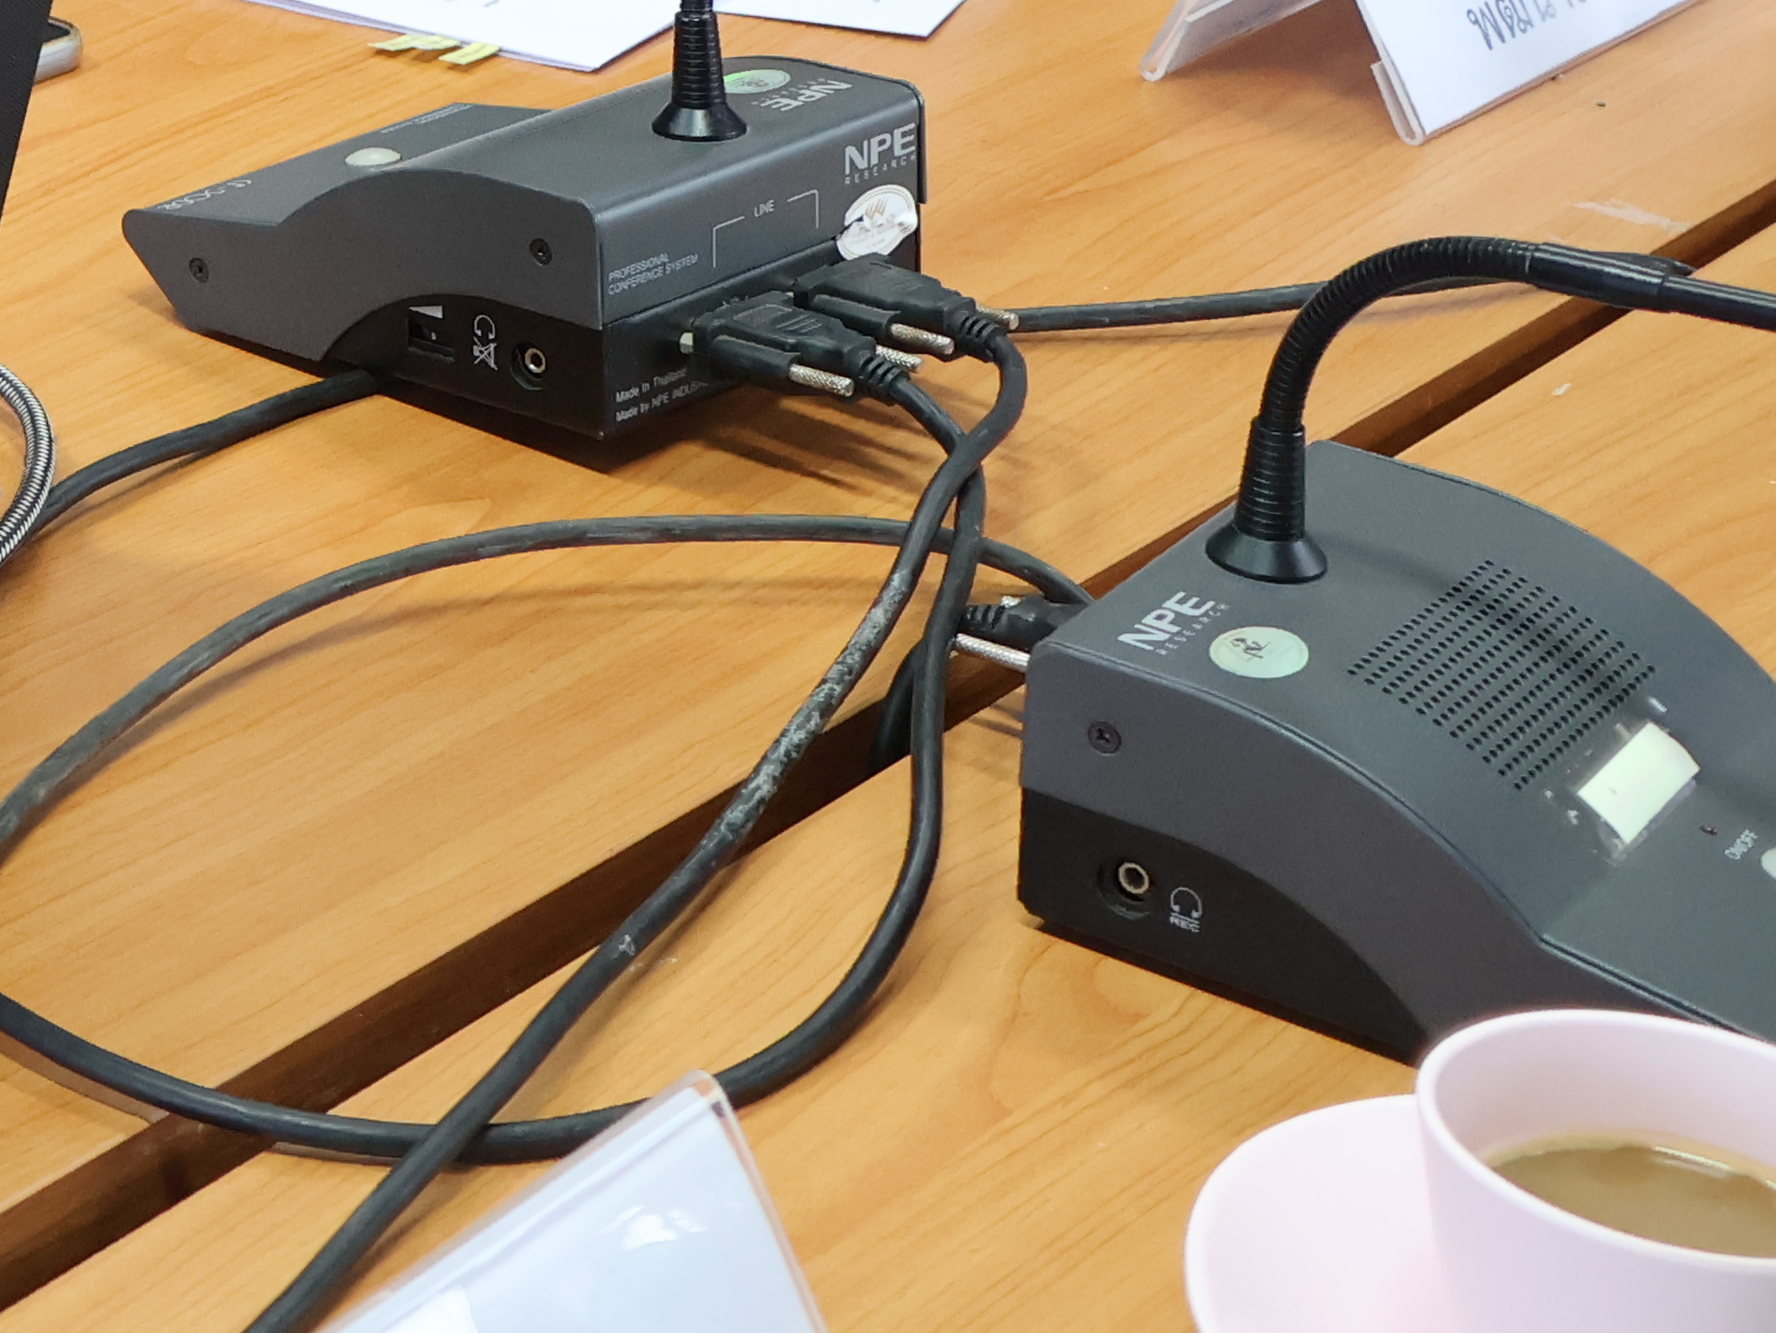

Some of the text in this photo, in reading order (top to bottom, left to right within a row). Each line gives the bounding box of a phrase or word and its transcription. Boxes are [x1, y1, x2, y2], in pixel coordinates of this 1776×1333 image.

[772, 79, 853, 113] NPE
[844, 123, 916, 176] NPE
[844, 155, 917, 186] RESEARCH
[754, 199, 776, 218] LINE
[608, 253, 670, 282] PROFESSIONAL
[608, 254, 698, 295] CONFERENCE SYSTEM
[615, 386, 640, 404] Made
[615, 405, 640, 422] Made
[651, 390, 671, 409] NPE
[1116, 591, 1217, 651] NPE
[1154, 602, 1231, 657] RESEARCH
[1722, 826, 1759, 862] ON/OFF
